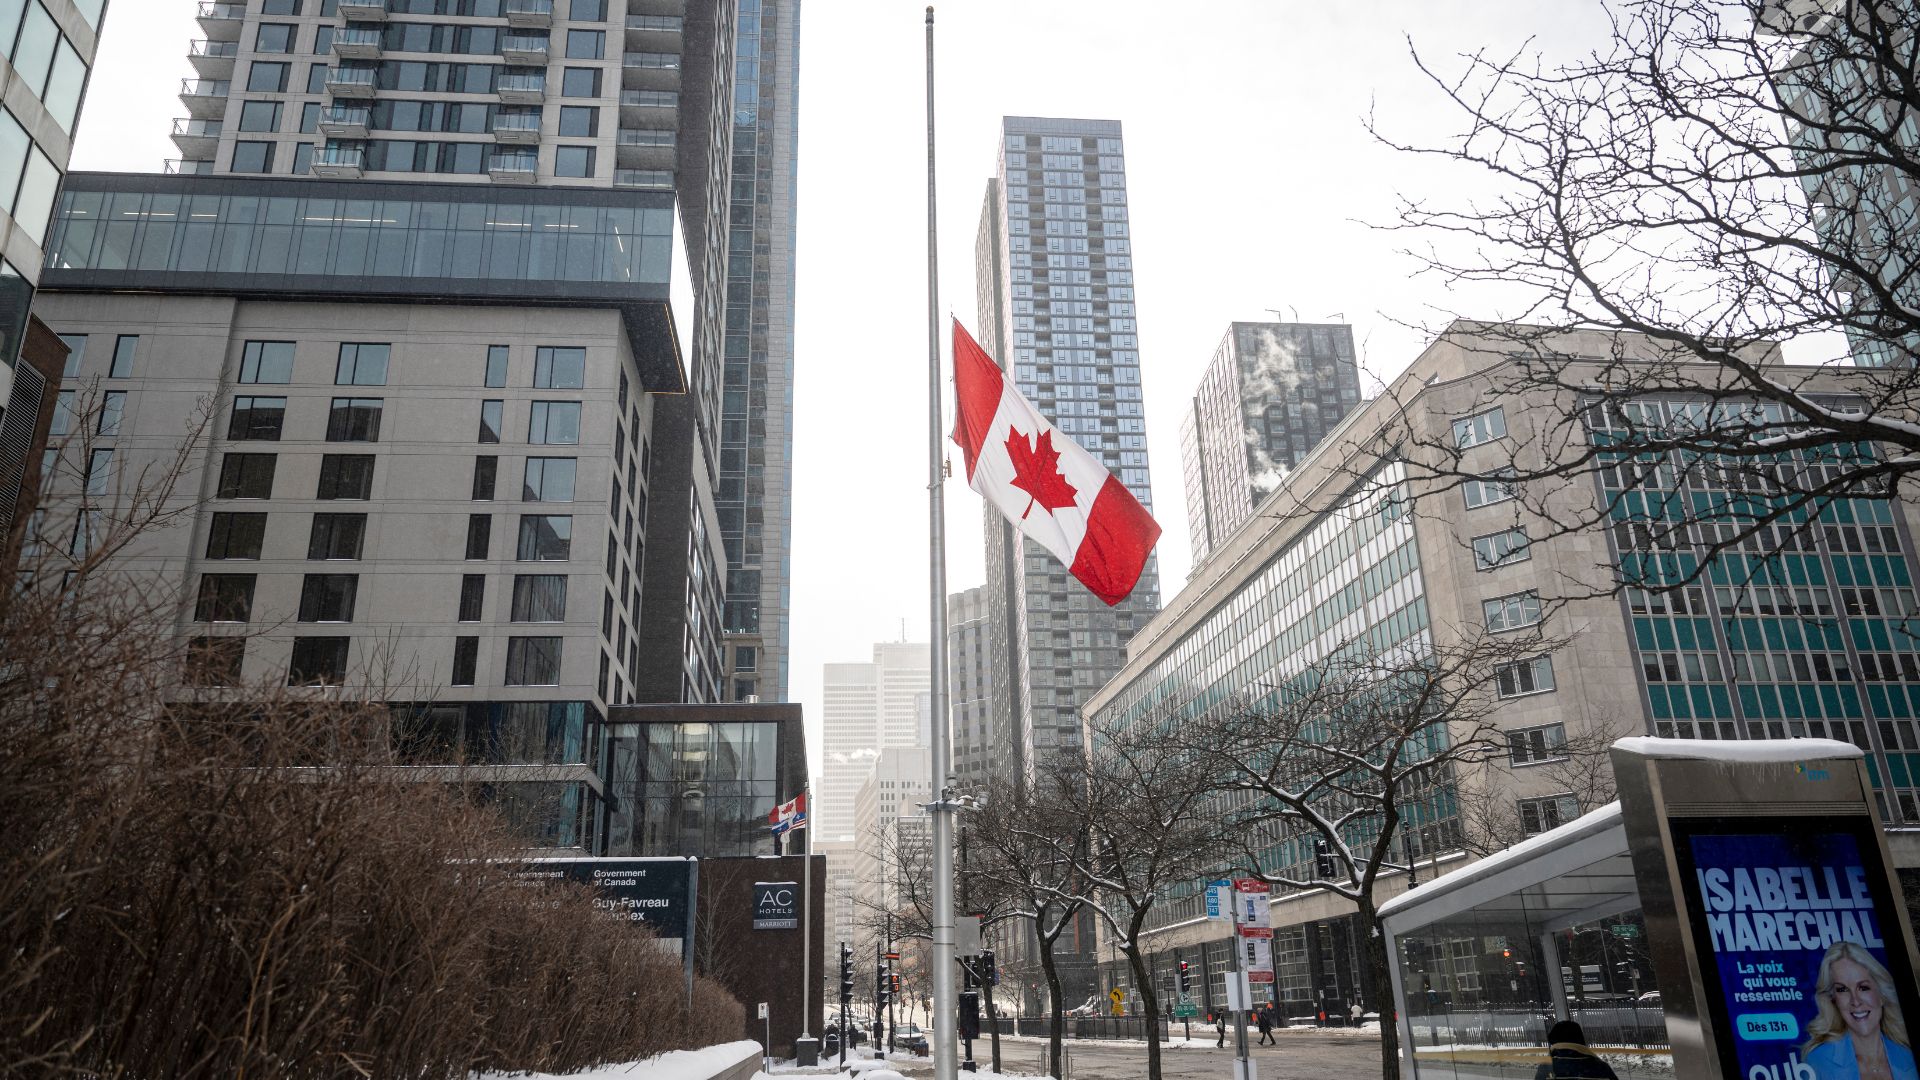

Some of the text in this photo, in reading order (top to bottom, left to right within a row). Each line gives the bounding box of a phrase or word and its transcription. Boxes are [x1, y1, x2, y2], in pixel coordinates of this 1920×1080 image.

[593, 869, 646, 878] Government
[604, 878, 636, 886] Canada
[1696, 866, 1874, 912] ISABELLE
[592, 897, 669, 910] Guy-Favreau
[760, 890, 792, 906] AC
[1706, 910, 1885, 952] MARECHAL
[1737, 960, 1784, 974] La voix
[1743, 974, 1797, 991] qui vous
[1735, 988, 1803, 1002] ressemble
[1746, 1021, 1768, 1032] Dès
